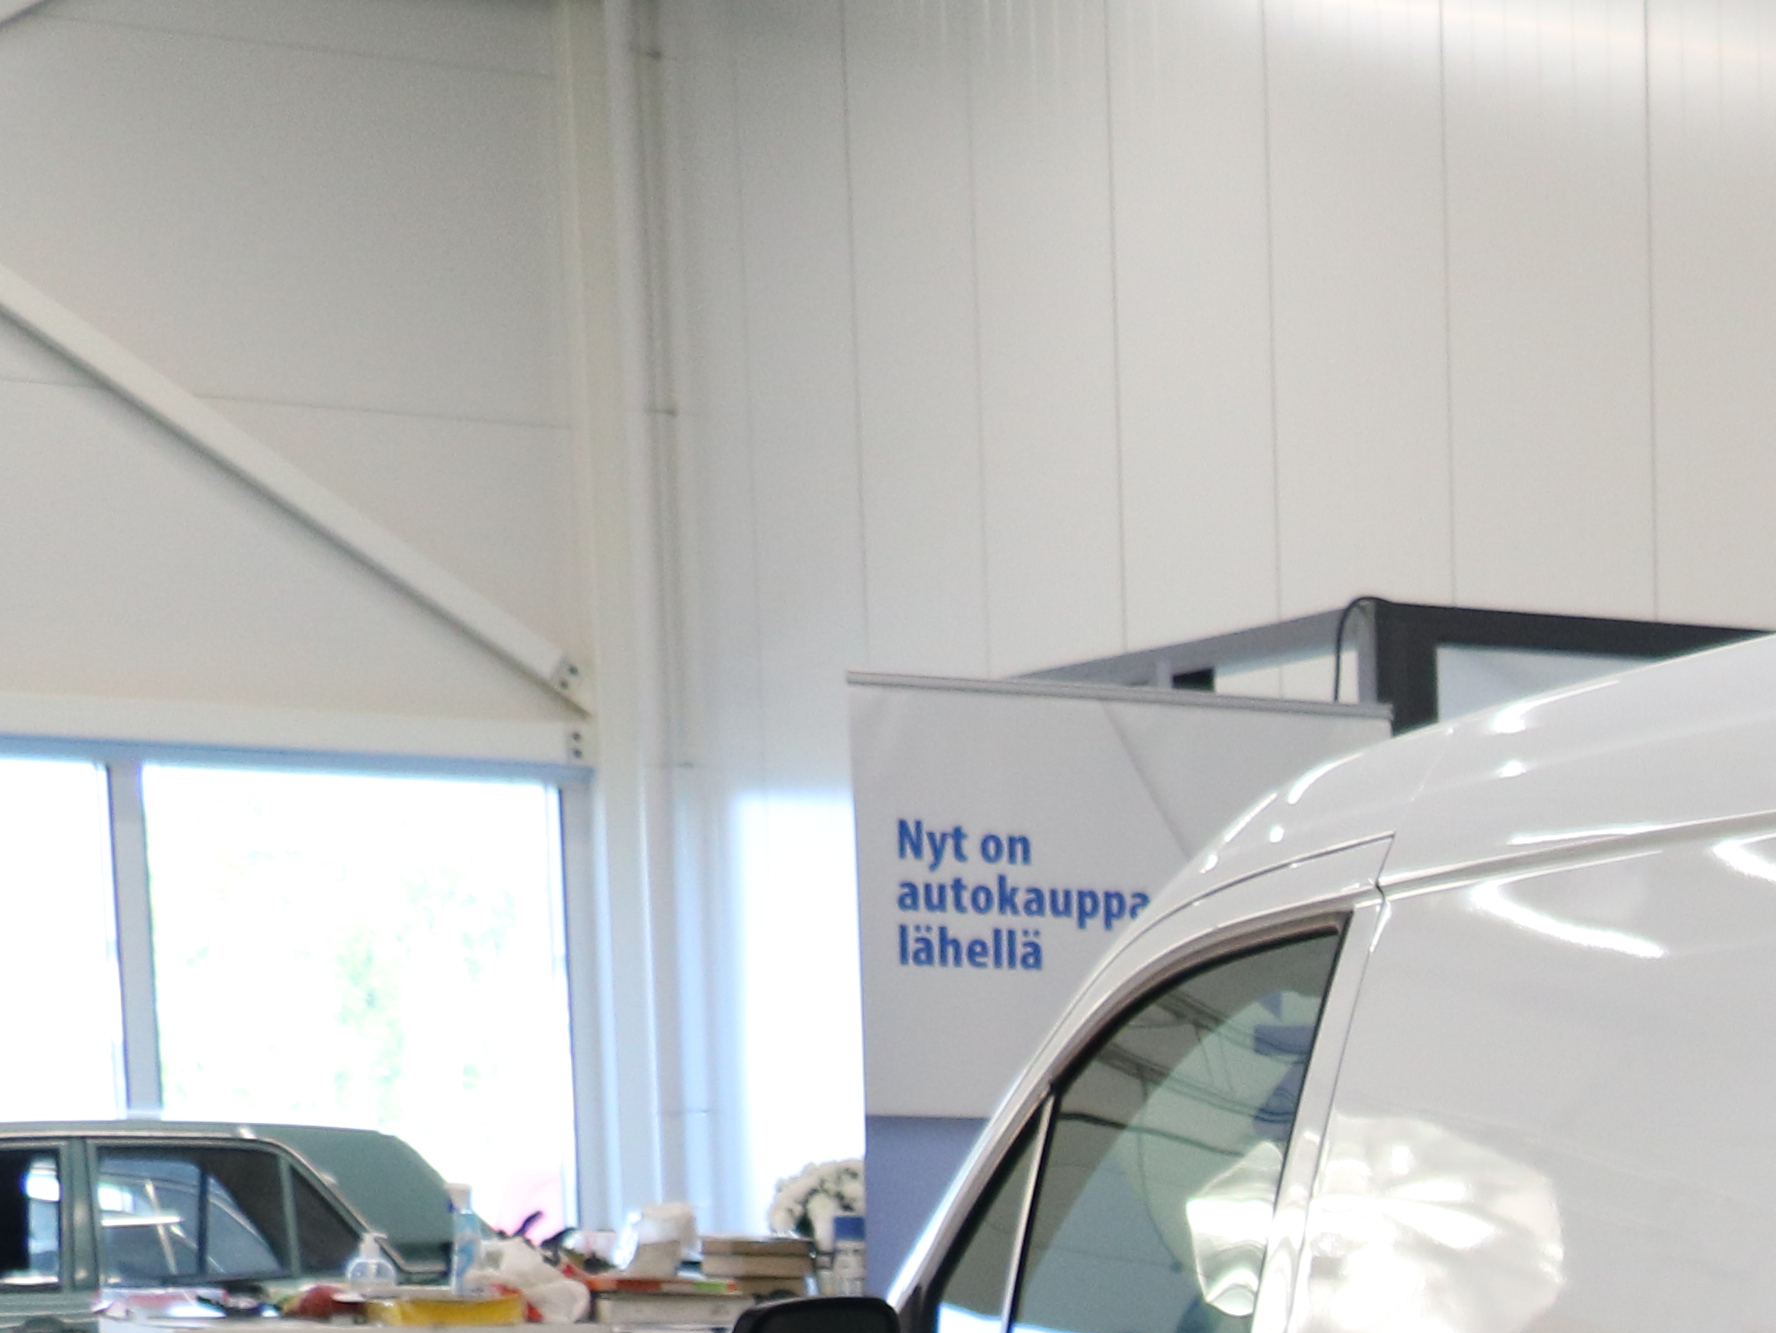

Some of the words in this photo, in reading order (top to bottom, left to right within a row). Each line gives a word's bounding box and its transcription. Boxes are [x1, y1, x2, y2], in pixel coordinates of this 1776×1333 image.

[897, 817, 969, 872] Nyt
[979, 833, 1032, 866] on
[898, 924, 1043, 971] lähellä
